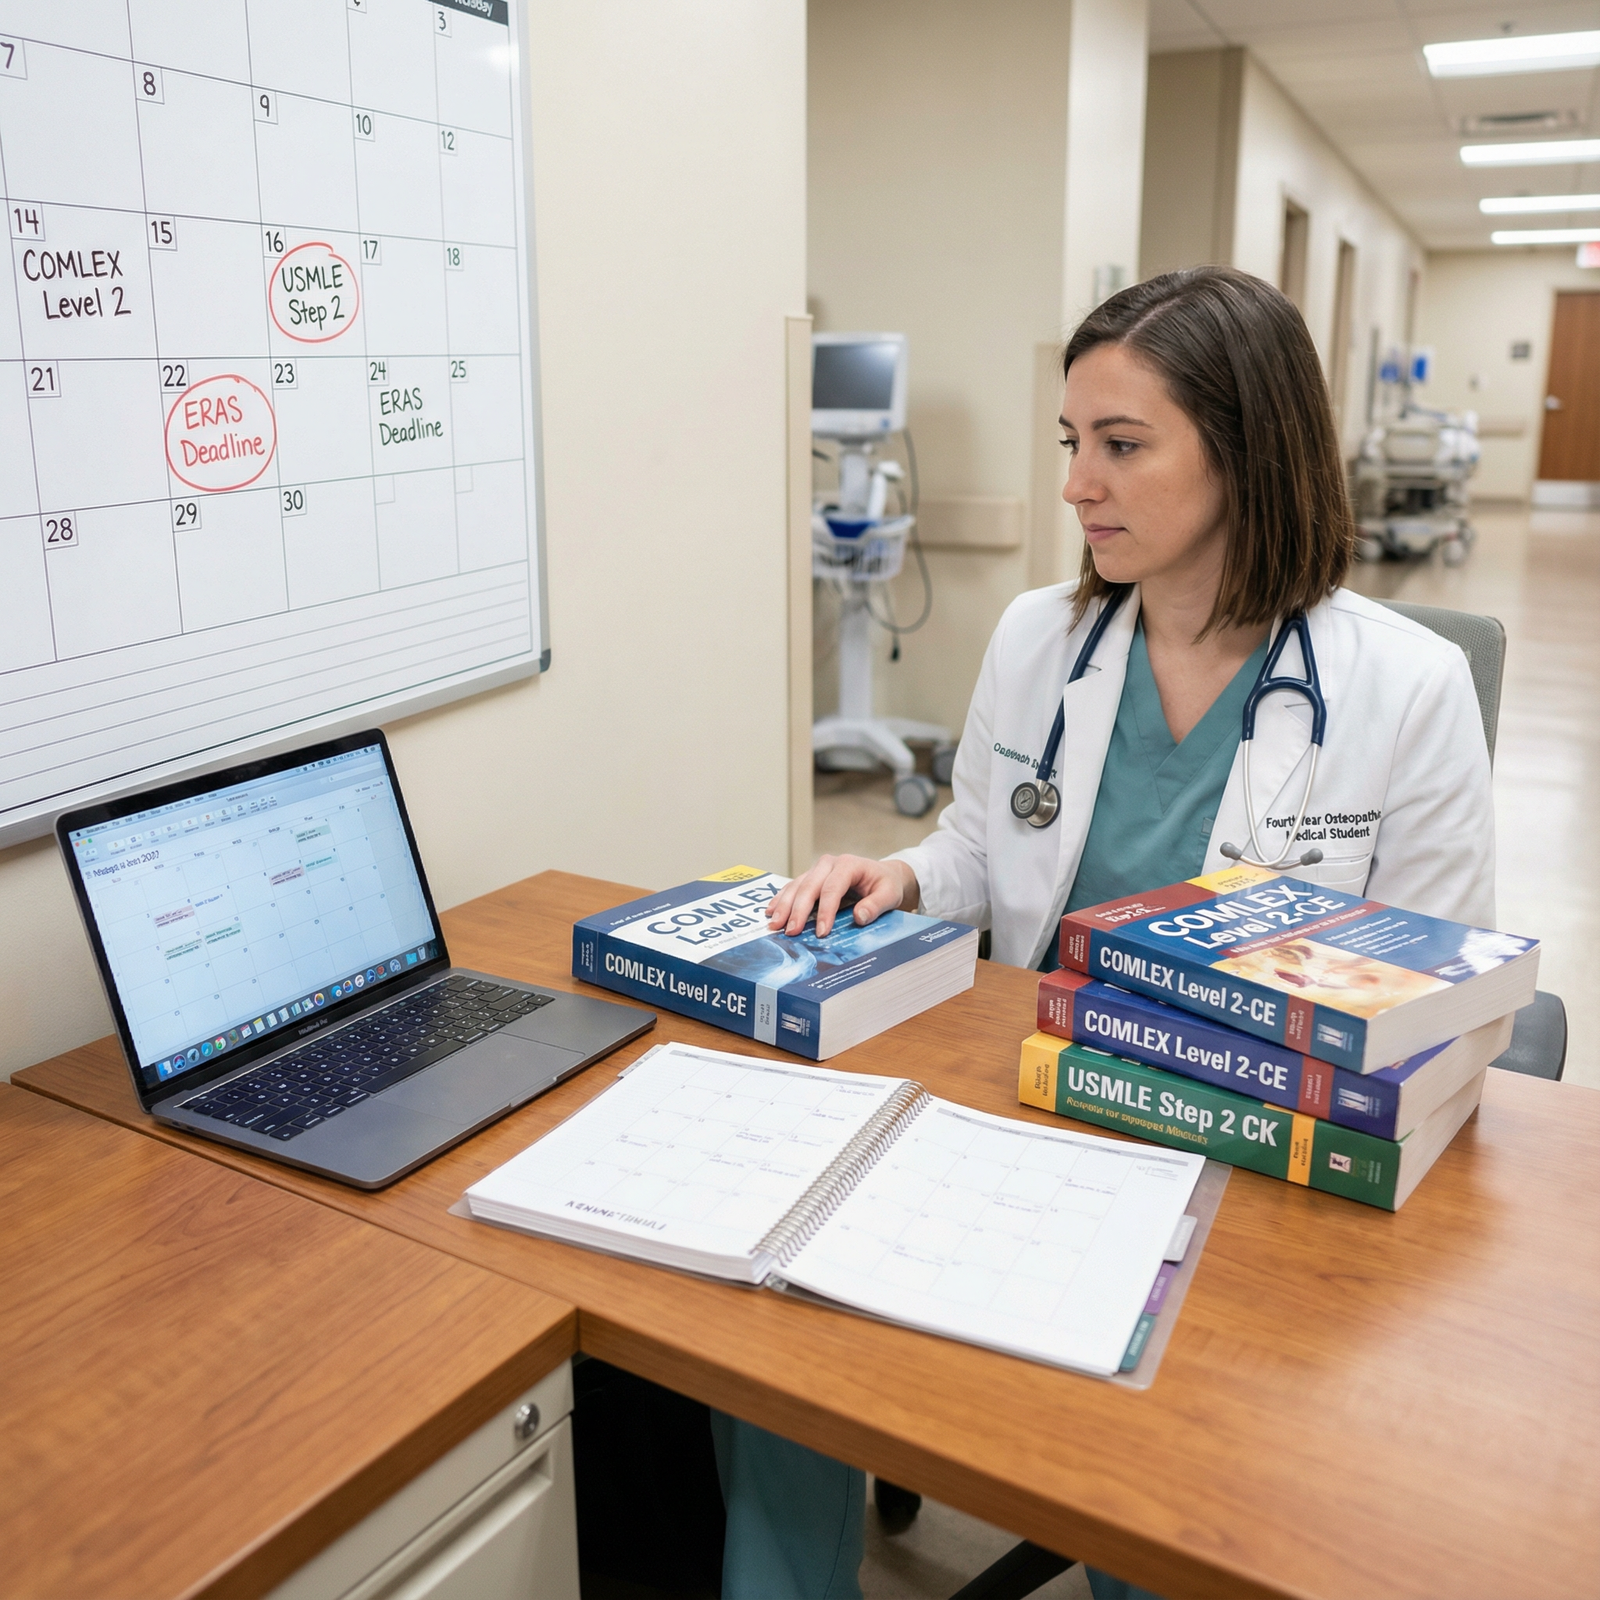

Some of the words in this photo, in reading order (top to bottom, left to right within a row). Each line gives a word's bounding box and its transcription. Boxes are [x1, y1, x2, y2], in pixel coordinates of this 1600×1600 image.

[438, 11, 446, 31] 3
[0, 42, 15, 69] 7
[143, 71, 156, 96] 8
[259, 95, 270, 117] 9
[356, 114, 372, 135] 10
[441, 131, 455, 151] 12
[14, 208, 39, 235] 14
[151, 220, 173, 244] 15
[265, 231, 284, 253] 16
[363, 240, 378, 259] 17
[23, 249, 123, 281] COMLEX
[446, 247, 461, 266] 18
[281, 264, 343, 293] USMLE
[43, 287, 103, 320] Level
[111, 286, 131, 317] 2
[288, 299, 327, 331] Step
[331, 295, 345, 320] 2
[31, 367, 54, 391] 21
[163, 364, 187, 387] 22
[274, 363, 295, 384] 23
[370, 361, 387, 381] 24
[451, 360, 467, 378] 25
[184, 395, 243, 430] ERAS
[380, 387, 423, 416] ERAS
[379, 417, 444, 446] Deadline
[180, 433, 266, 467] Deadline
[283, 489, 304, 512] 30
[175, 502, 197, 526] 29
[46, 517, 74, 543] 28
[1329, 825, 1371, 840] Student
[647, 882, 782, 935] COMLEX
[1148, 883, 1313, 937] COMLEX
[675, 913, 760, 945] Level
[1183, 917, 1277, 949] Level
[1266, 895, 1347, 926] 2-CE
[605, 953, 666, 990] COMLEX
[669, 973, 708, 1003] Level
[711, 988, 748, 1017] 2-CE
[1100, 946, 1175, 990] COMLEX
[1178, 972, 1227, 1009] Level
[1230, 992, 1277, 1027] 2-CE
[1084, 1010, 1170, 1055] COMLEX
[1175, 1036, 1231, 1073] Level
[1235, 1055, 1289, 1091] 2-CE
[1068, 1066, 1152, 1112] USMLE
[1158, 1091, 1214, 1133] Step
[1219, 1109, 1236, 1135] 2
[1242, 1114, 1279, 1147] CK
